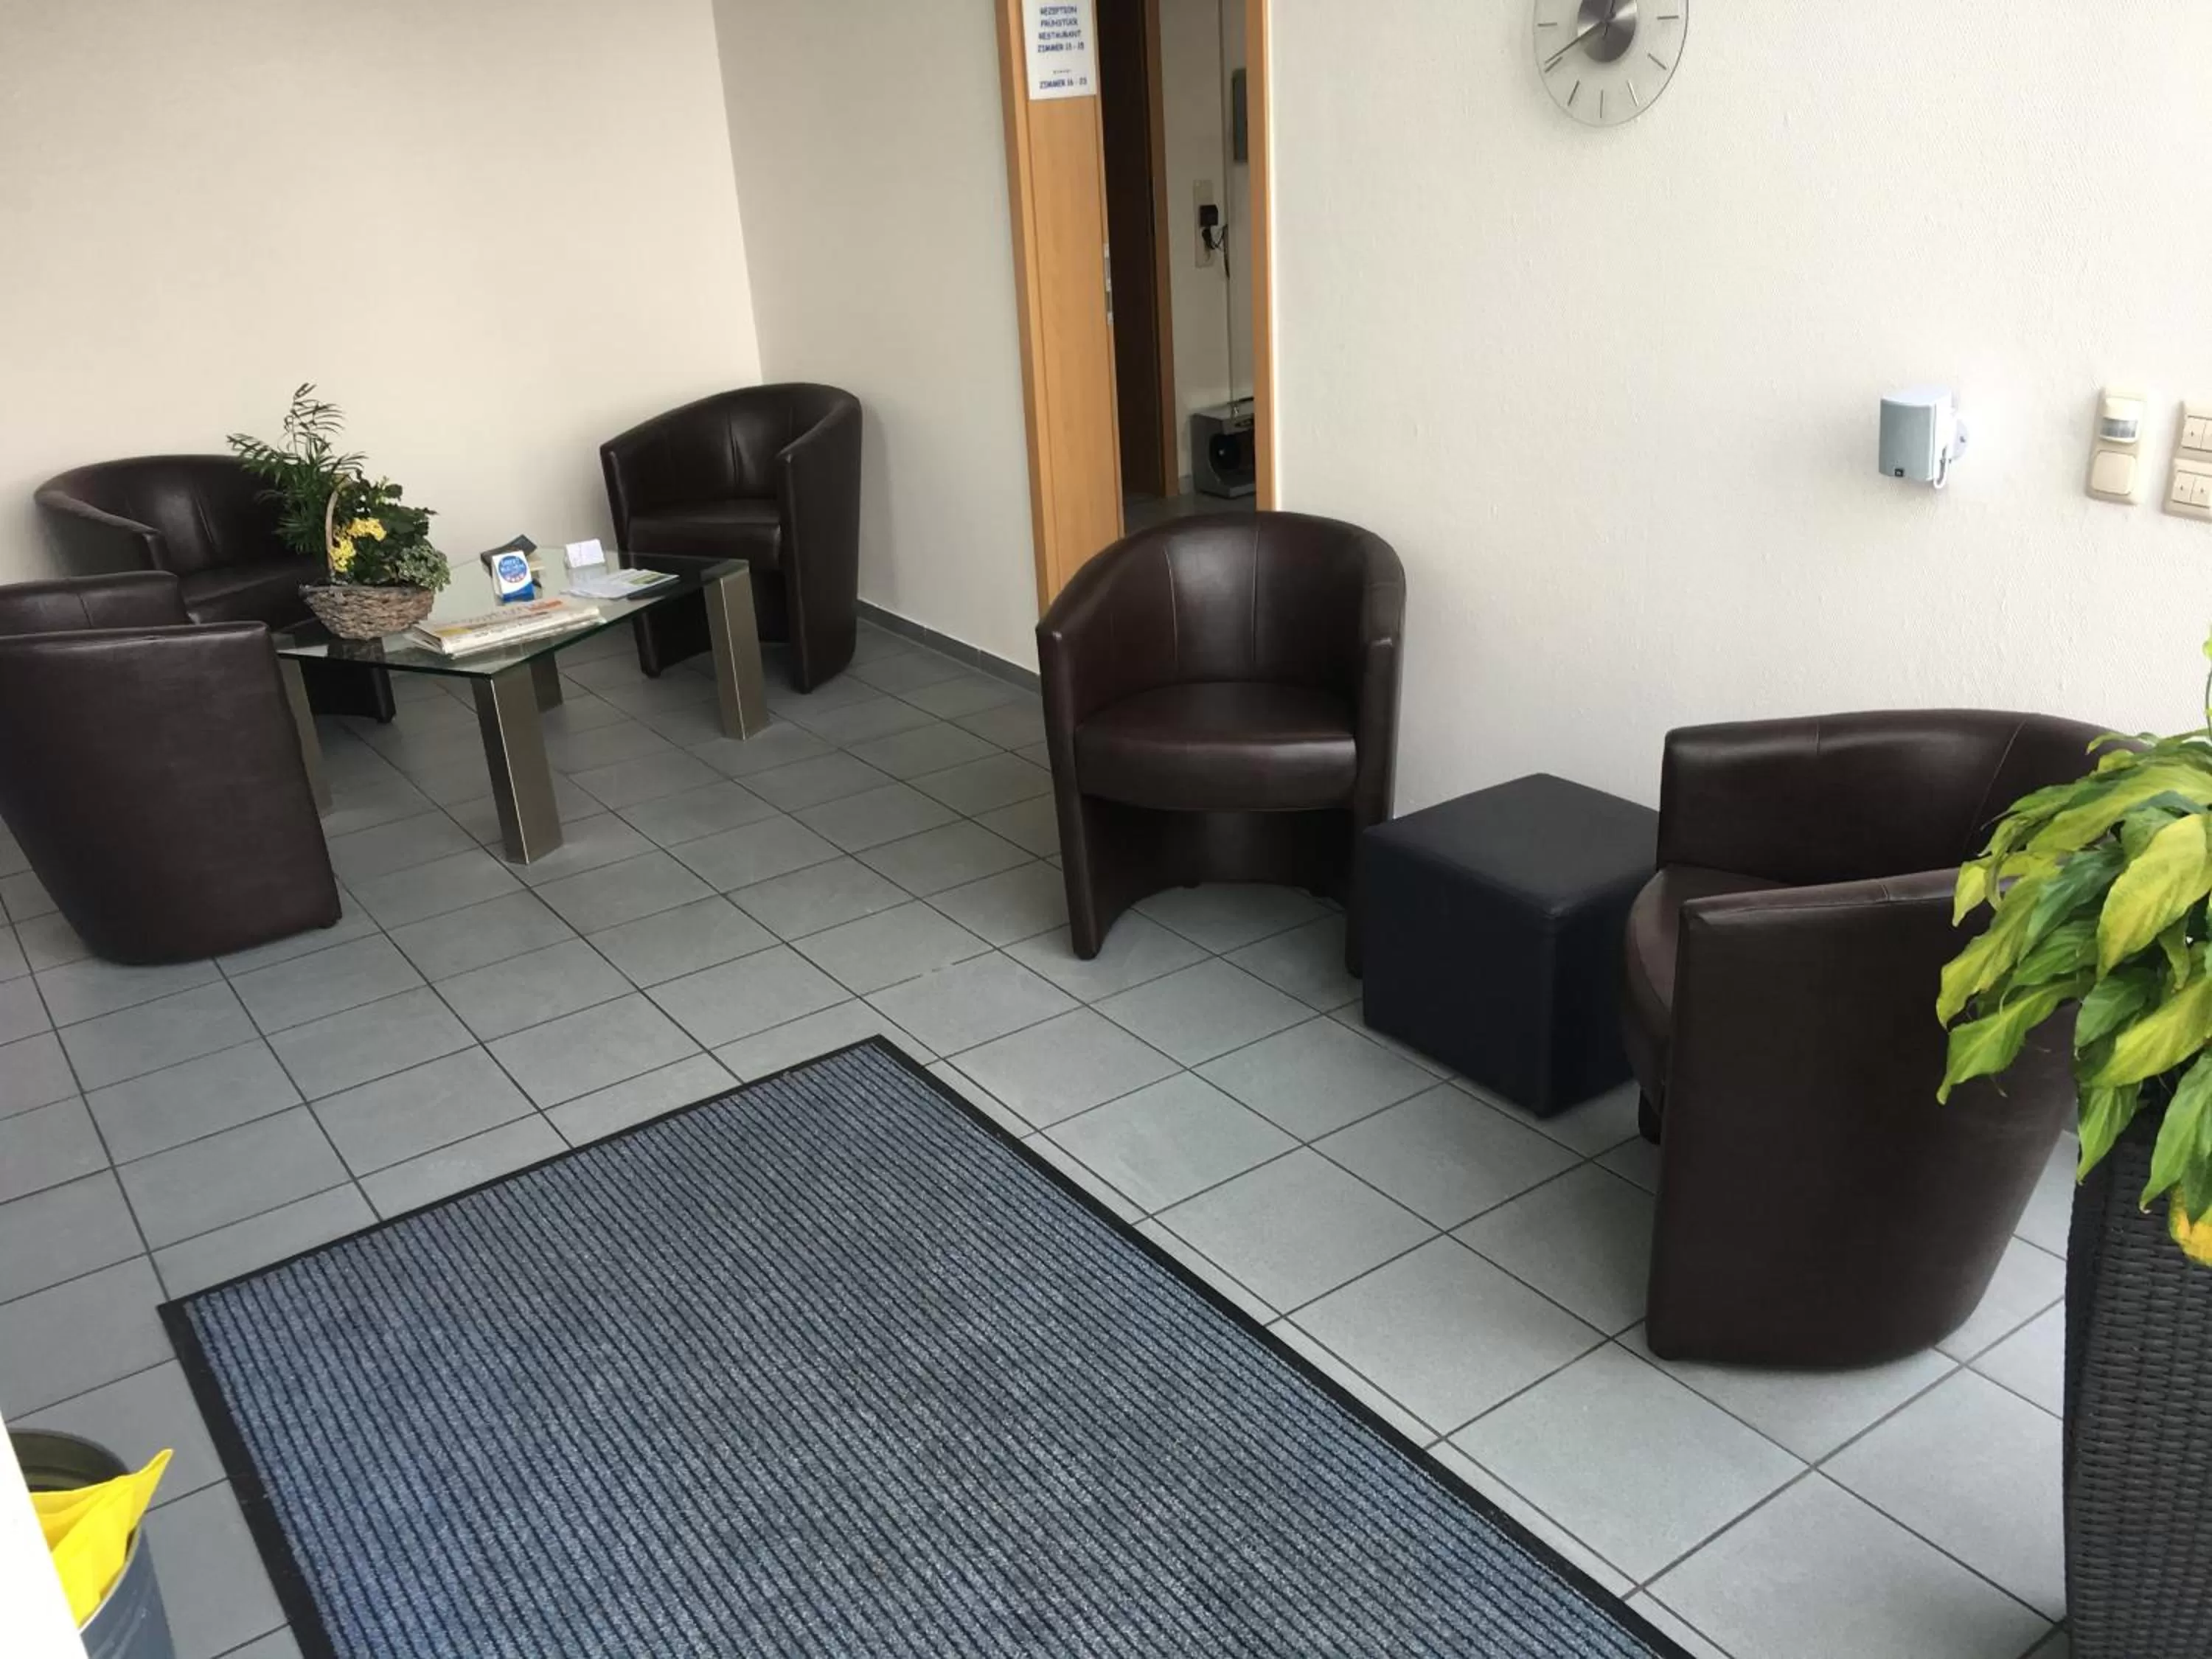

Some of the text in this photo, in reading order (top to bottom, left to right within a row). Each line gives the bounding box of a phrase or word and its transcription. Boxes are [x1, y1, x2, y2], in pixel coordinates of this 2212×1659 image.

[1040, 6, 1077, 15] REZEPTION
[1038, 29, 1082, 40] RESTAURANT
[1037, 44, 1063, 53] ZIMMER
[1039, 79, 1065, 89] ZIMMER
